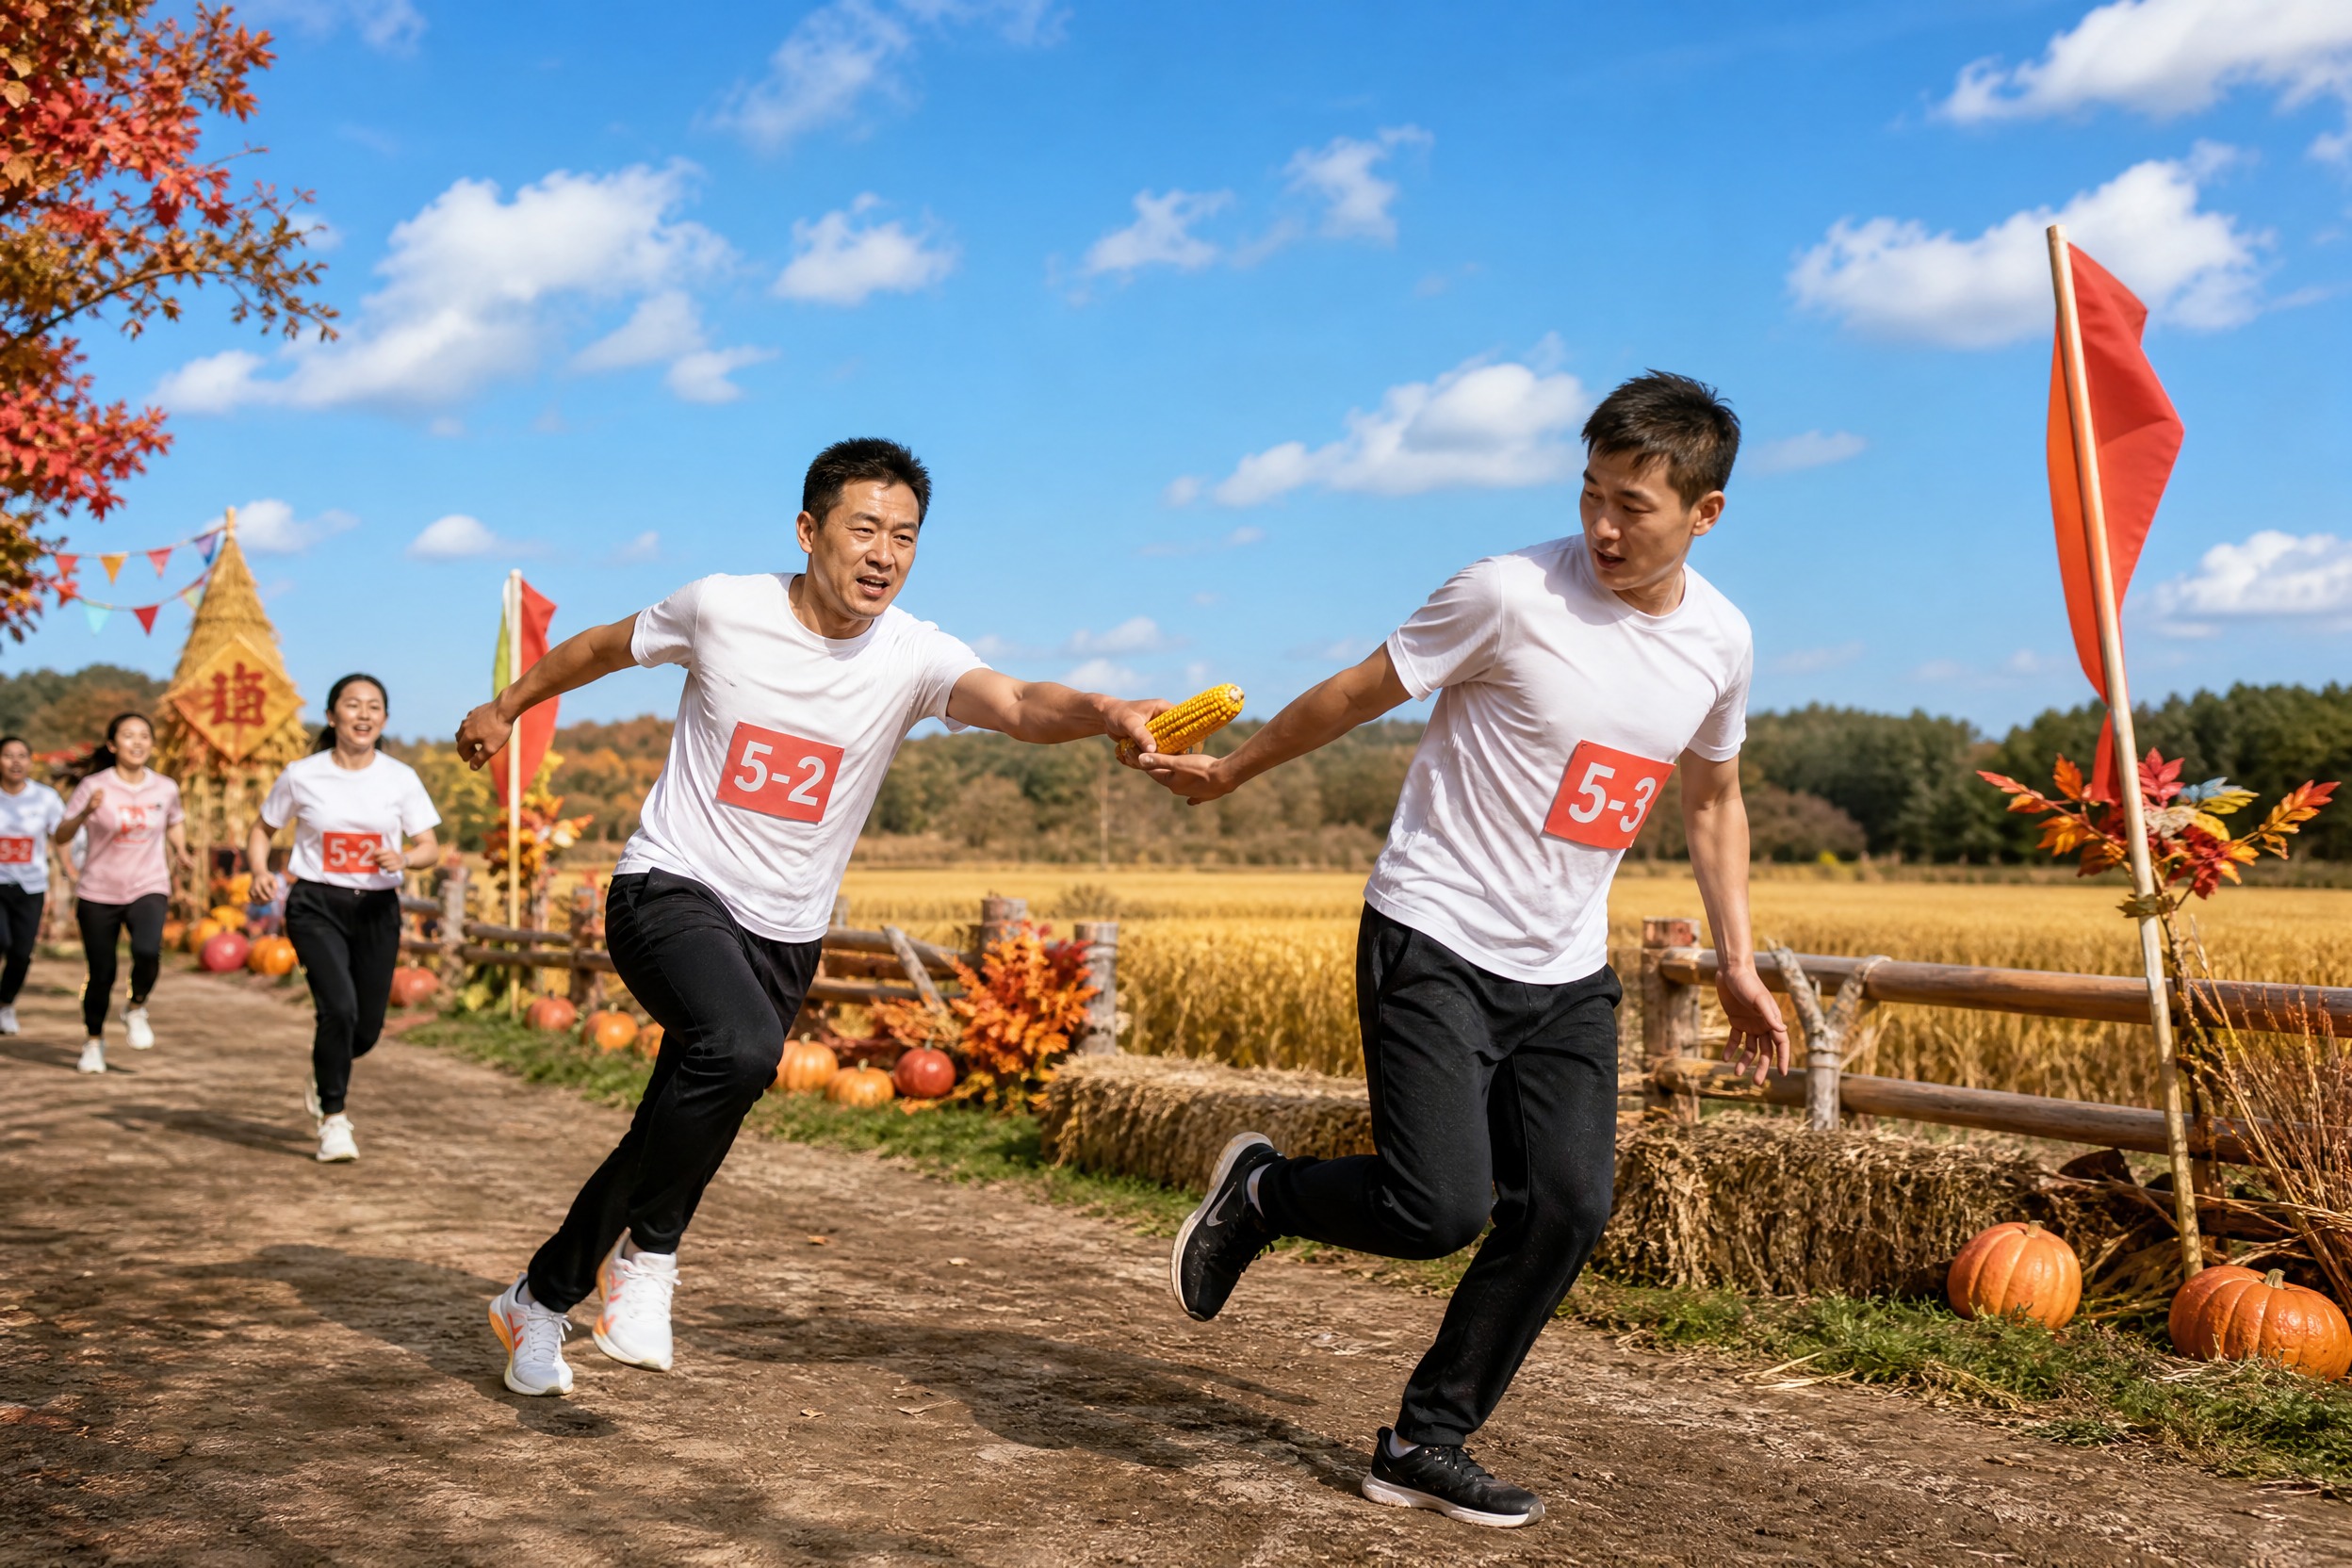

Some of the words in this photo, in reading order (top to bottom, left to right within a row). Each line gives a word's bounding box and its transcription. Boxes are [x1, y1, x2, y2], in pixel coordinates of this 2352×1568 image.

[734, 740, 825, 807] 5-2
[1568, 761, 1657, 833] 5-3
[329, 838, 376, 867] 5-2
